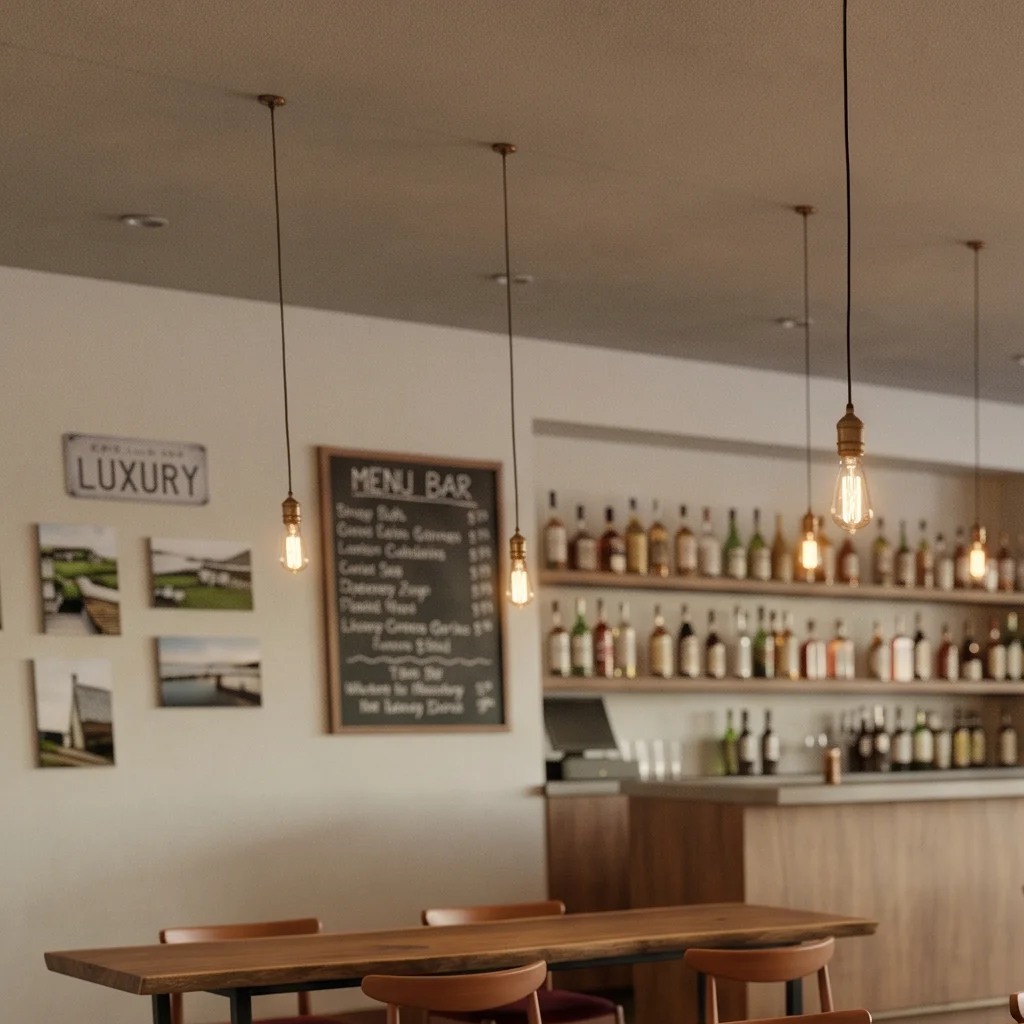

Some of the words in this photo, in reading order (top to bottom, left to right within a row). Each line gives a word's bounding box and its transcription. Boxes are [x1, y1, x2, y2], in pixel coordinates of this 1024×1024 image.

[78, 457, 199, 497] LUXURY
[351, 466, 414, 496] MENU
[425, 470, 473, 500] BAR
